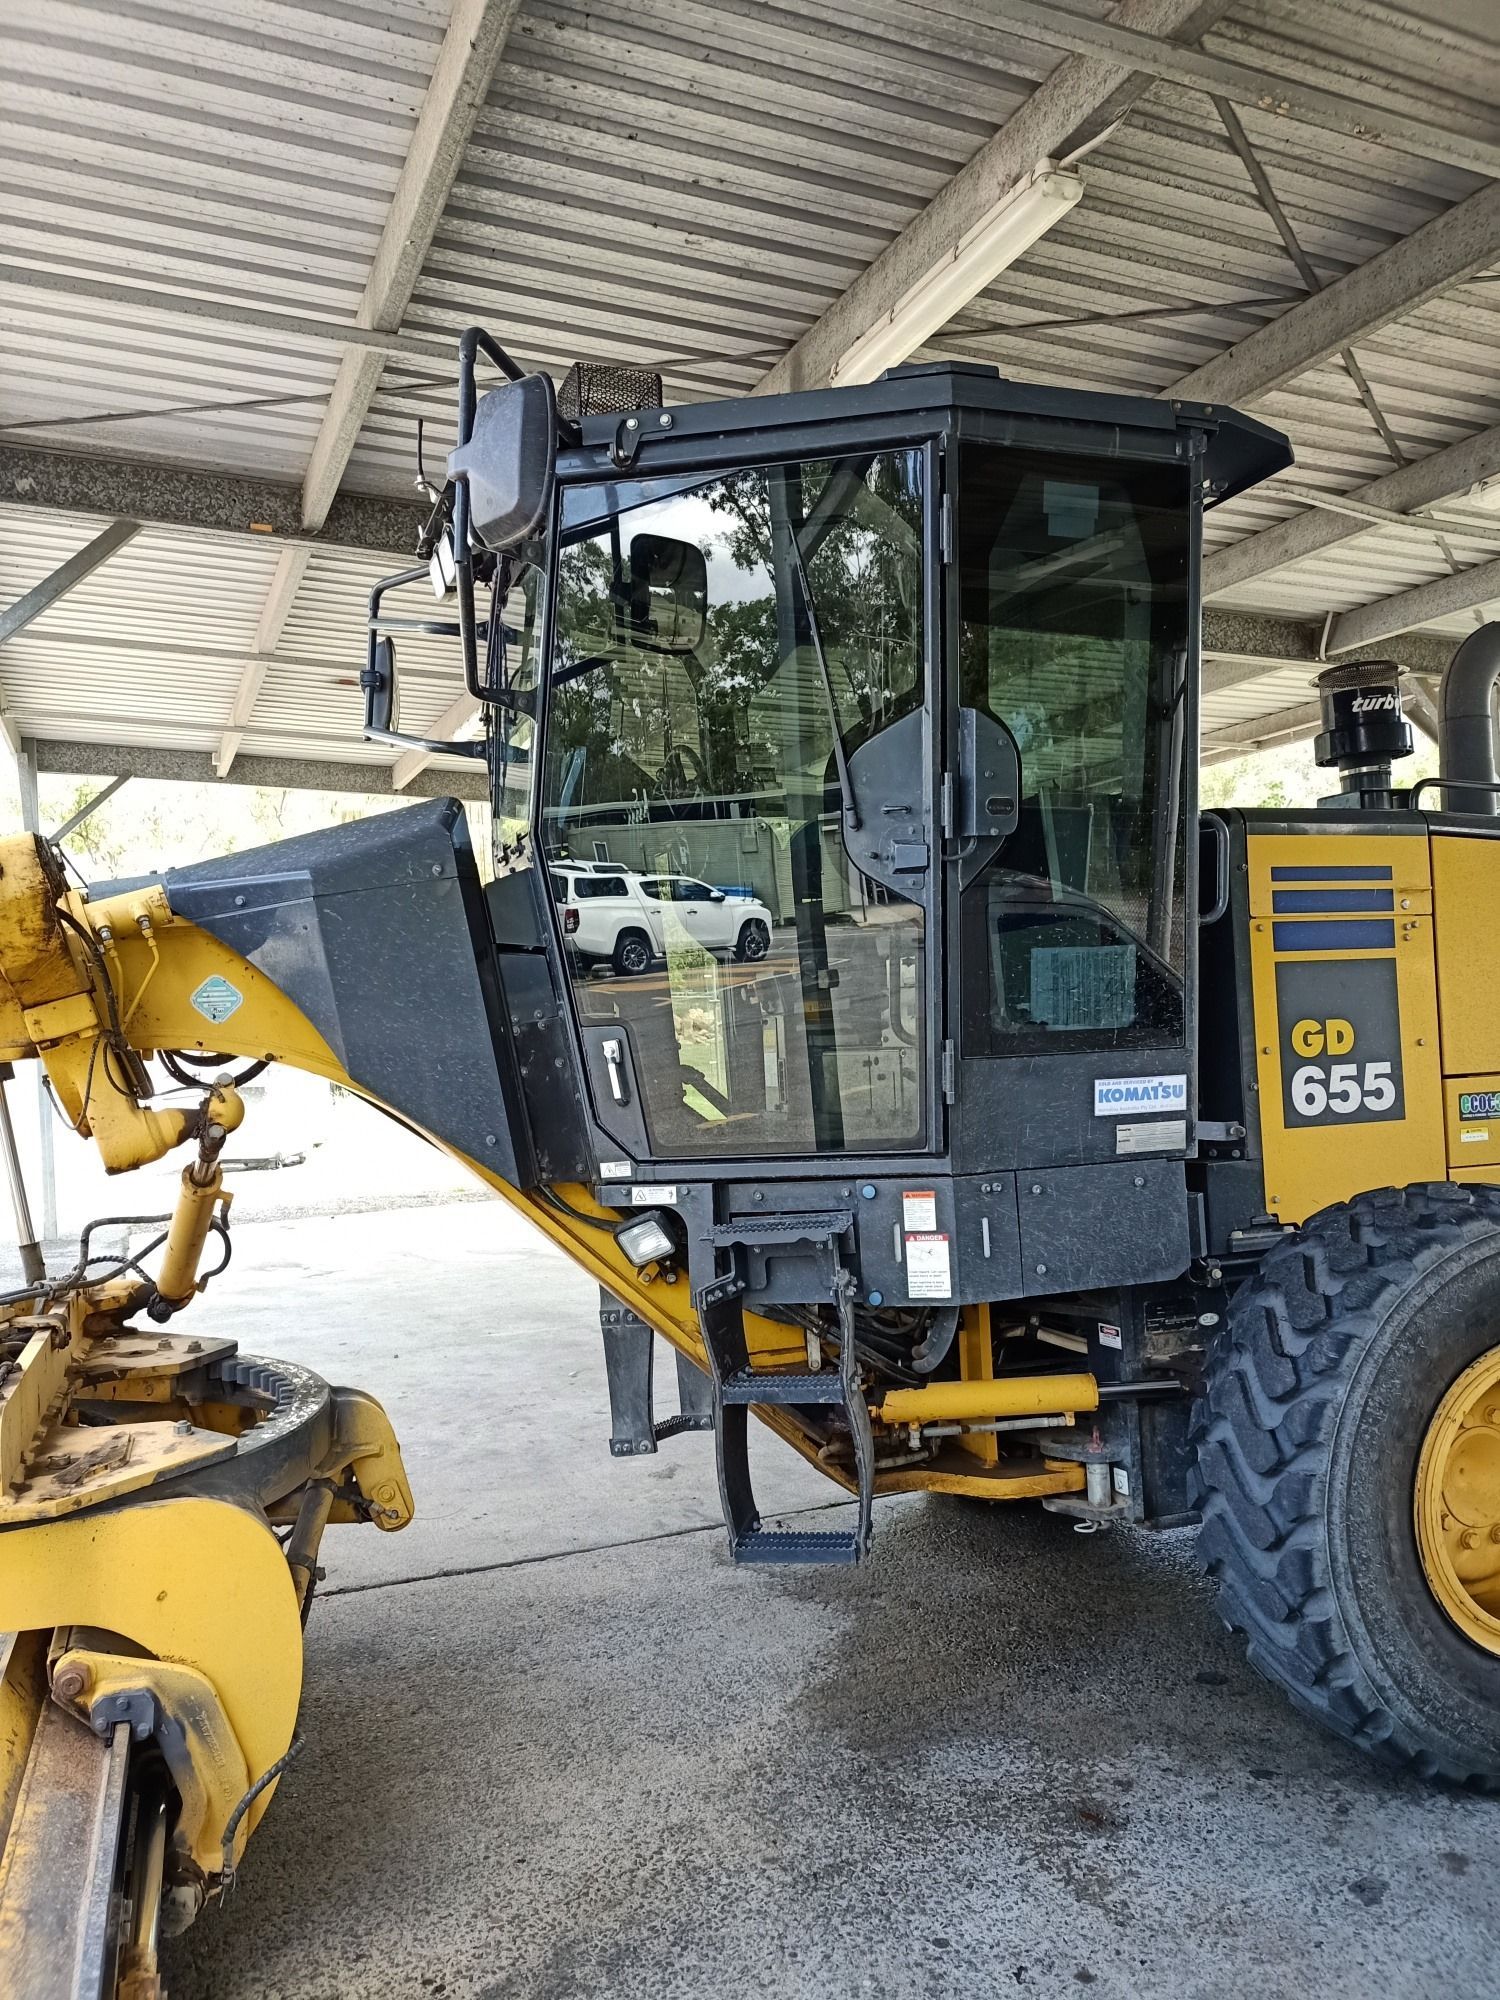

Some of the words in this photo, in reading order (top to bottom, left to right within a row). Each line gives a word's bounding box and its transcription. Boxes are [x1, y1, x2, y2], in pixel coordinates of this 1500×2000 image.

[1291, 1018, 1355, 1058] GD
[1098, 1081, 1184, 1104] KOMATSU
[1291, 1061, 1396, 1117] 655
